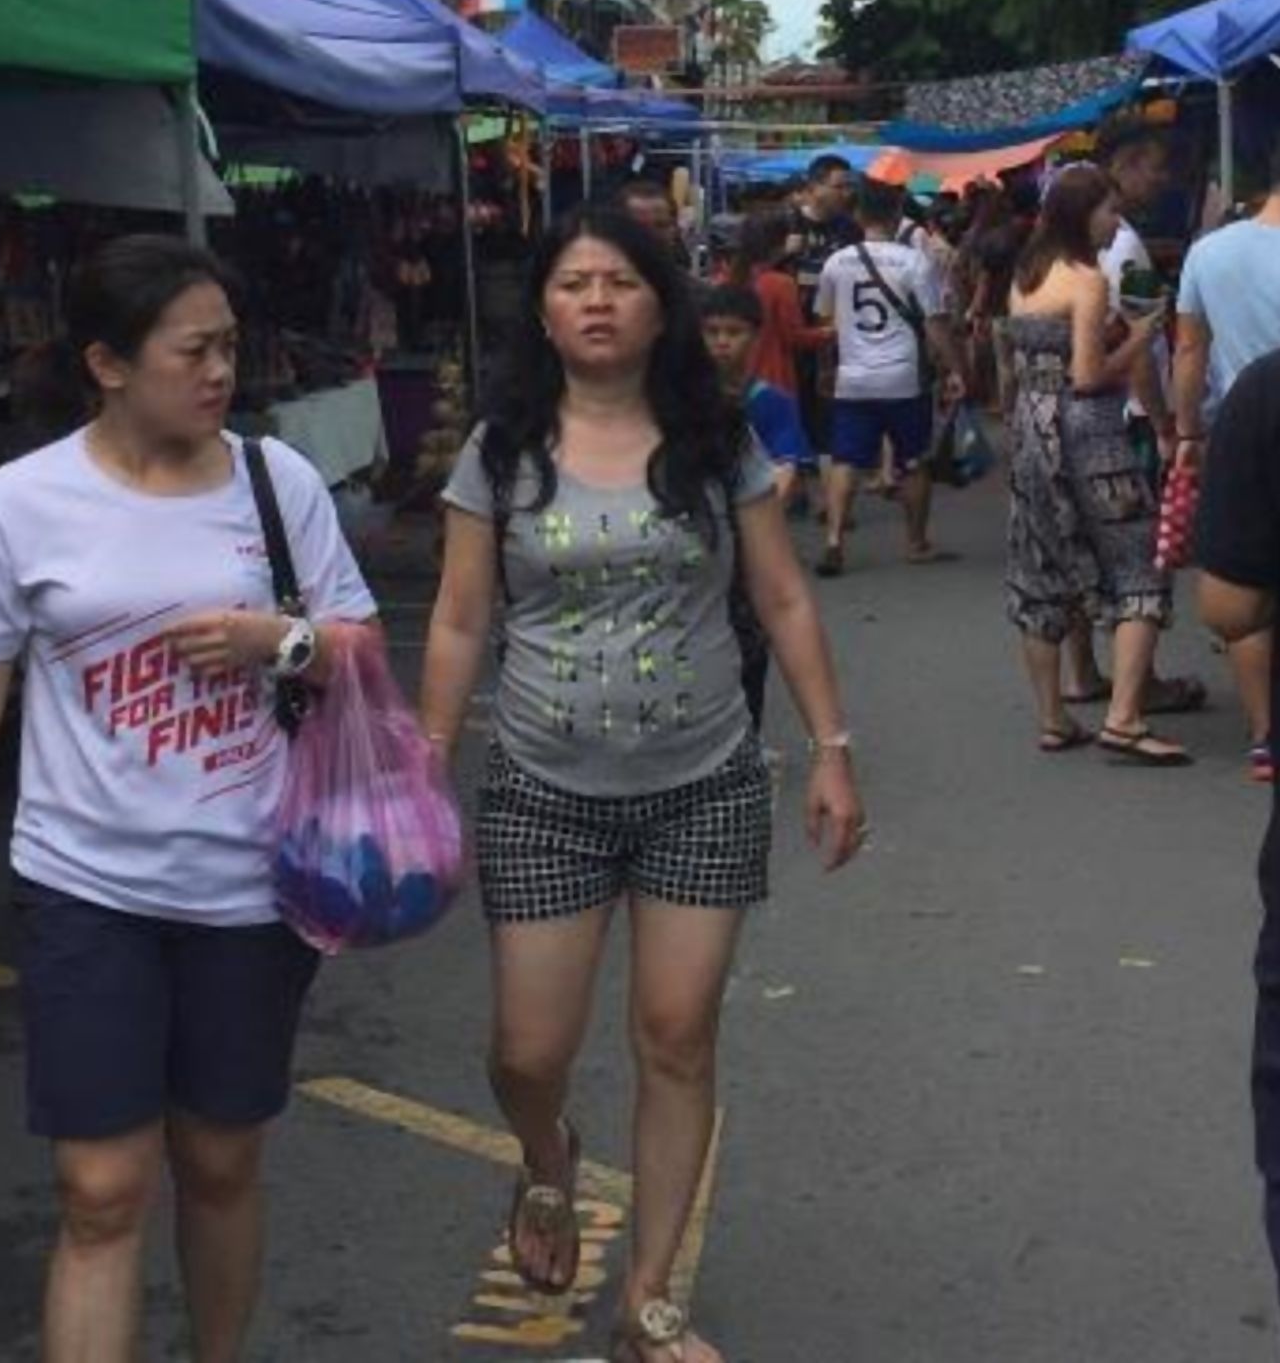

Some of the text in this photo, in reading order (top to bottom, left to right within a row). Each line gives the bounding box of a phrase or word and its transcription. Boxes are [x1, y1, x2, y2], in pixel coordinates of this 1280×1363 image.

[853, 279, 889, 333] 5
[83, 632, 180, 715] FIG
[110, 683, 175, 737] FOR
